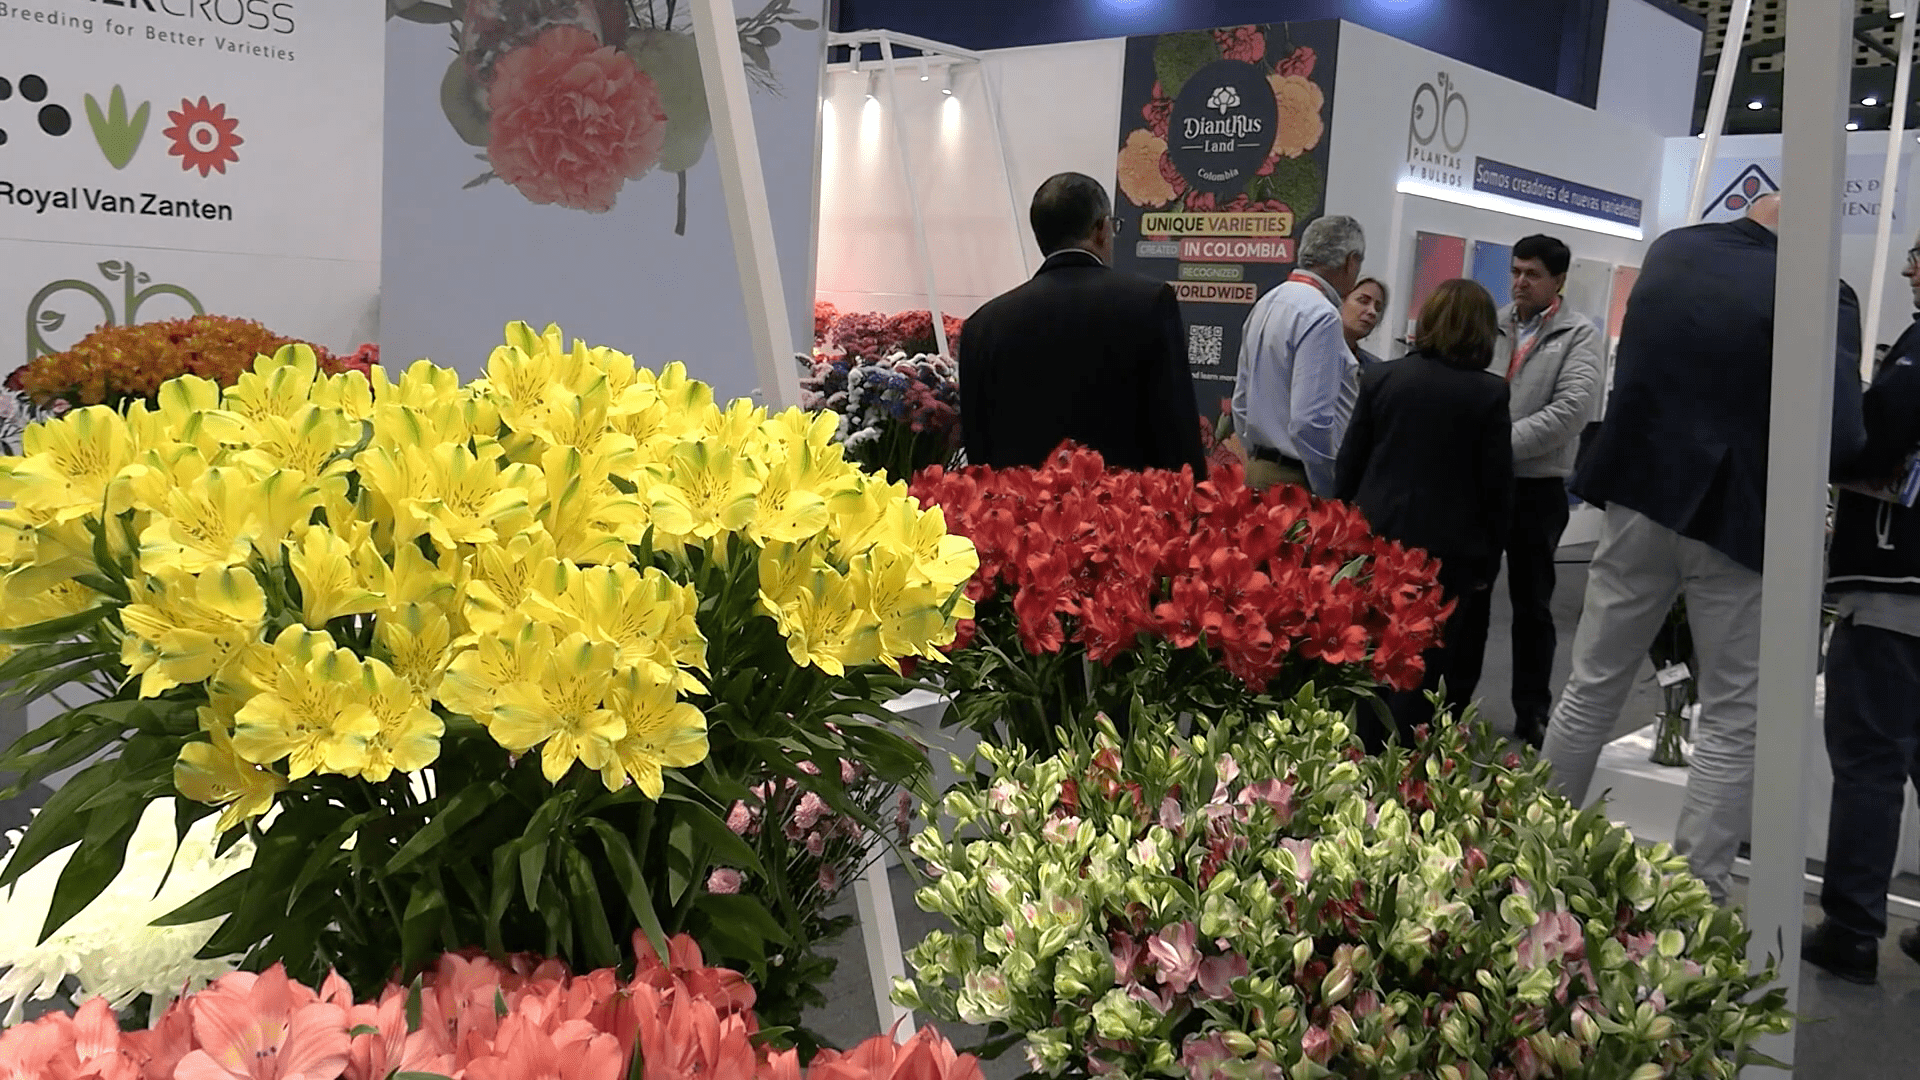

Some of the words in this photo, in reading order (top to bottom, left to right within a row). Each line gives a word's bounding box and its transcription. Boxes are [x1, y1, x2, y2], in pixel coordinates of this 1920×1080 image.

[0, 2, 93, 34] Breeding
[106, 18, 135, 36] for
[145, 25, 205, 47] Better
[215, 36, 295, 61] Varieties
[1183, 115, 1262, 139] Dianthus
[1204, 139, 1235, 153] Land
[1413, 147, 1461, 170] PLANTAS
[1197, 168, 1240, 182] Colombia
[1410, 164, 1416, 177] Y
[1421, 167, 1462, 188] BULBOS
[1475, 163, 1511, 189] Somos
[1511, 177, 1557, 201] creadores
[1558, 185, 1570, 203] de
[0, 181, 77, 214] Royal
[83, 188, 135, 213] Van
[140, 193, 232, 221] Zanten
[1146, 217, 1204, 232] UNIQUE
[1208, 217, 1286, 232] VARIETIES
[1140, 245, 1178, 255] CREATED
[1184, 242, 1200, 257] IN
[1203, 242, 1288, 258] COLOMBIA
[1182, 267, 1240, 278] RECOGNIZED
